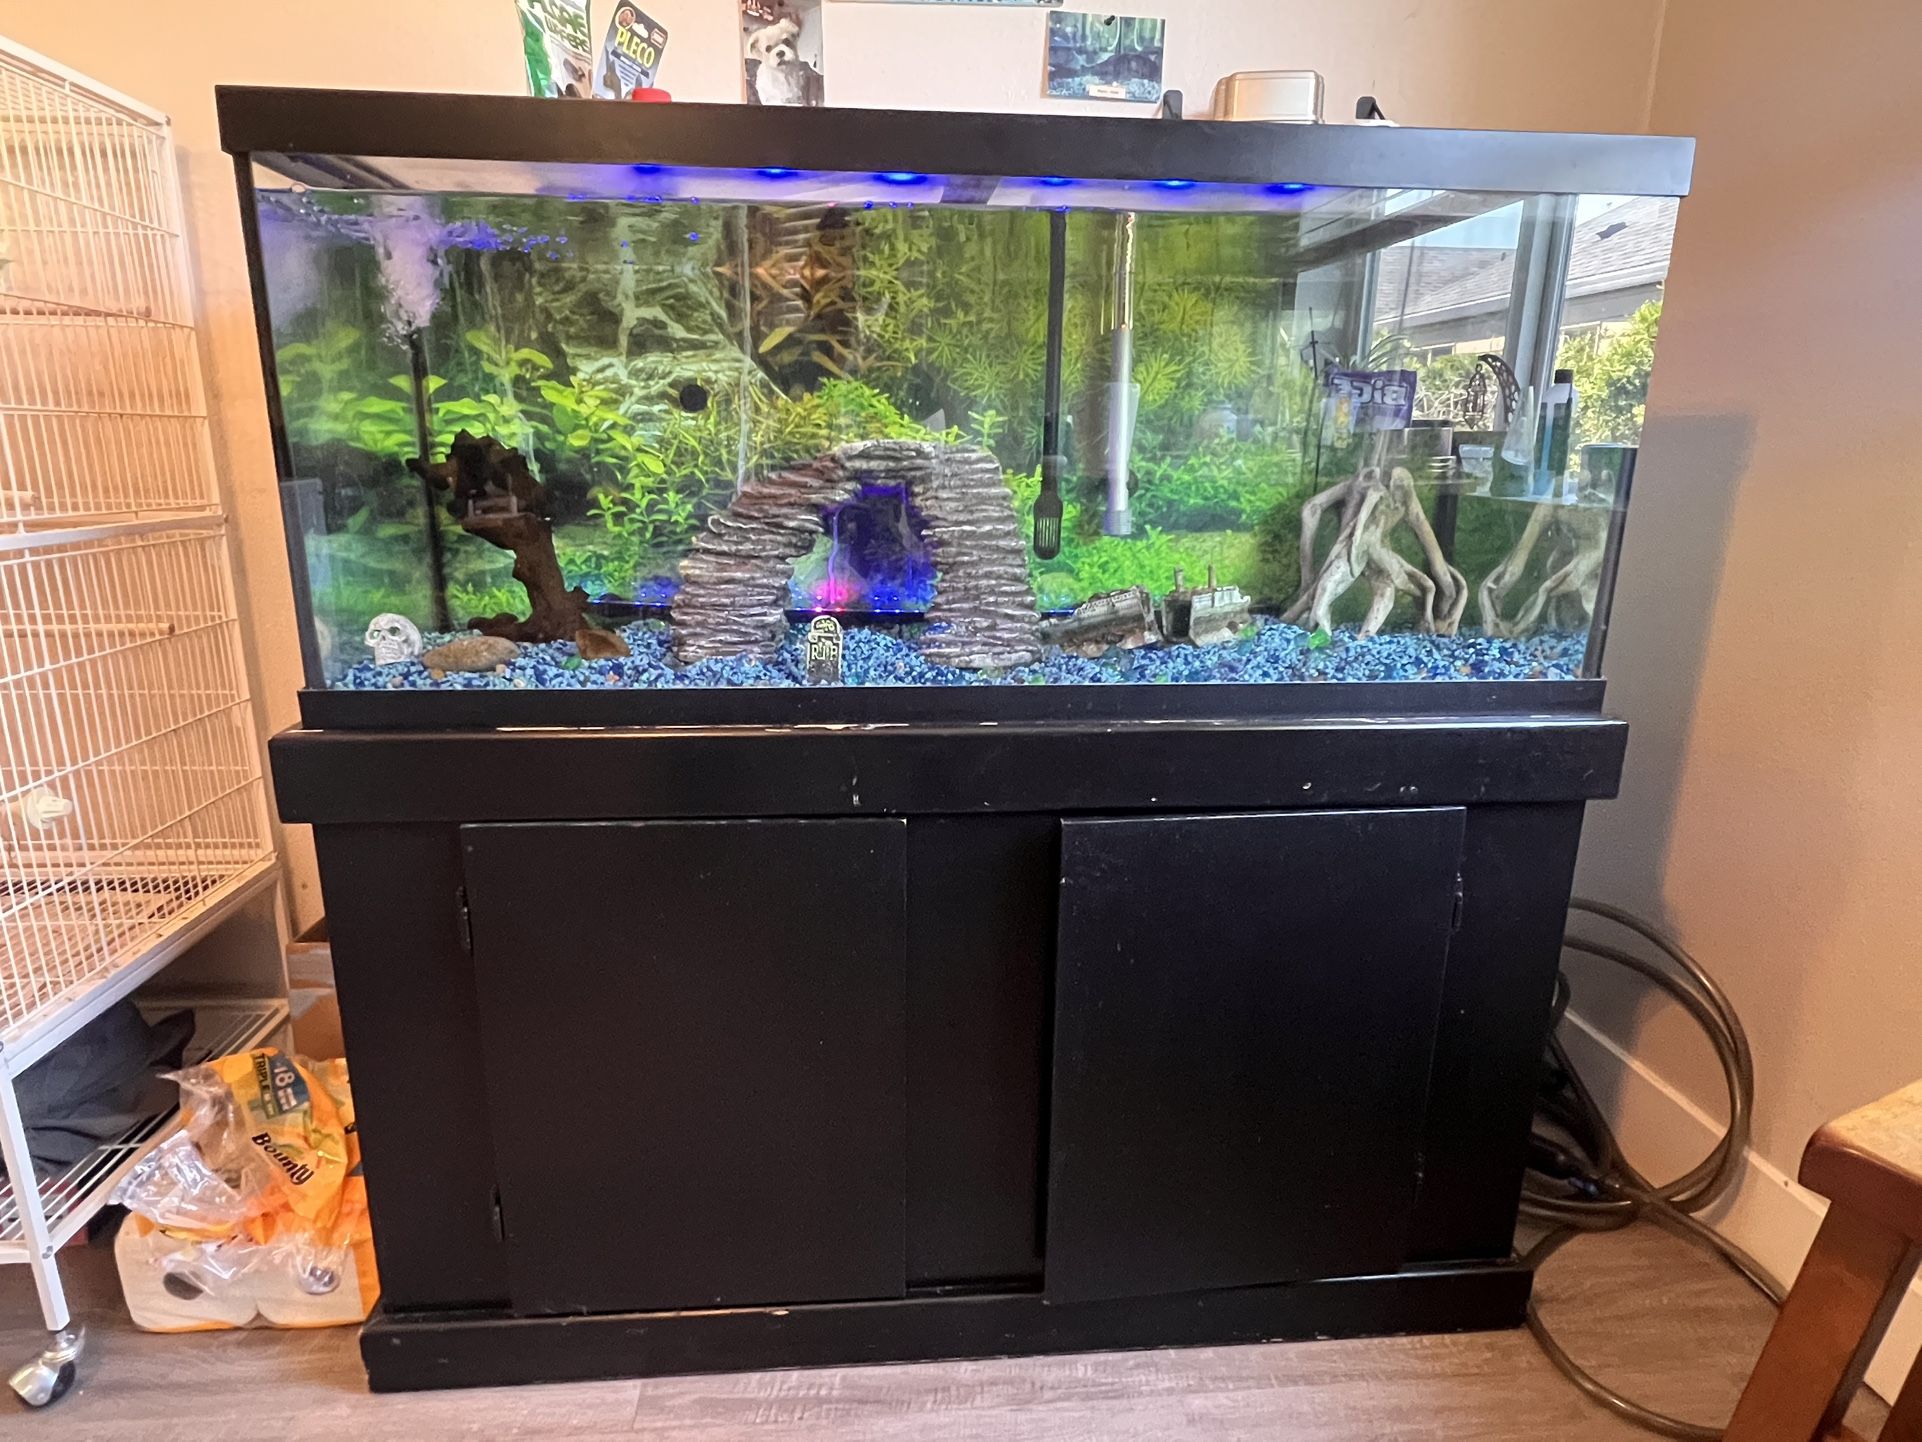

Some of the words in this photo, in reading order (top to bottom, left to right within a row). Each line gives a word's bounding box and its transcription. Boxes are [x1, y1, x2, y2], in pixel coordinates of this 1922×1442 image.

[614, 27, 656, 69] PLECO
[255, 1052, 271, 1091] TRIPLE
[273, 1066, 296, 1087] 18
[251, 1131, 315, 1186] Bounty
